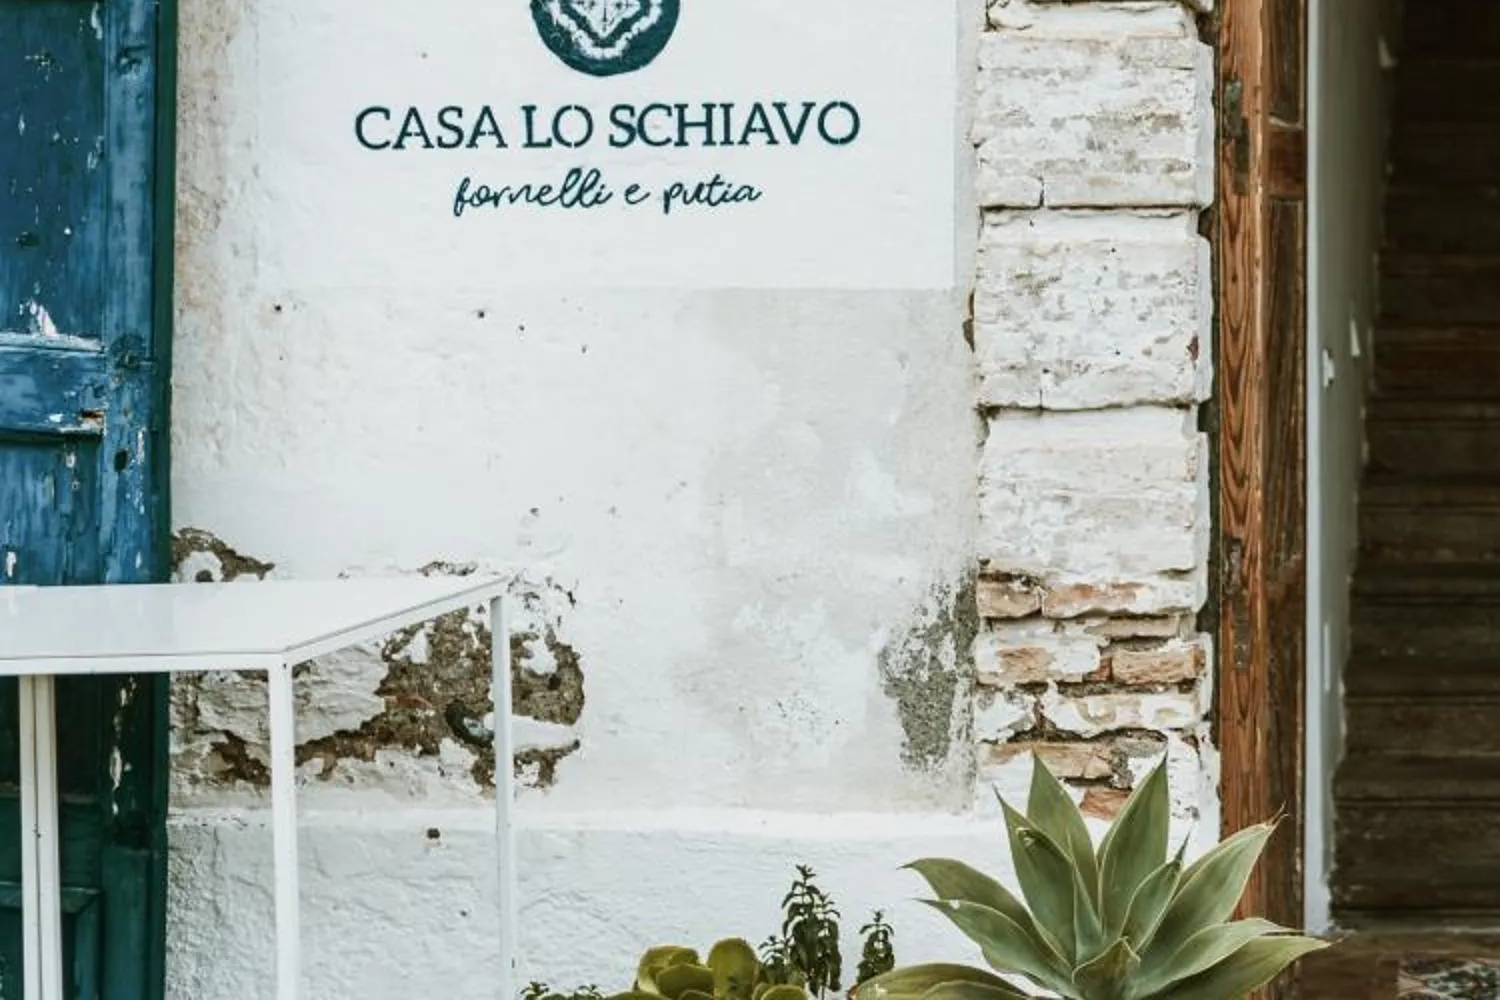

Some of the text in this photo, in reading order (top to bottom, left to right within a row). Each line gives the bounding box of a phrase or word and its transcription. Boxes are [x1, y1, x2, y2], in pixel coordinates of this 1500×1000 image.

[354, 100, 861, 151] CASA LO SCHIAVO
[453, 167, 763, 217] fornelli e putia
